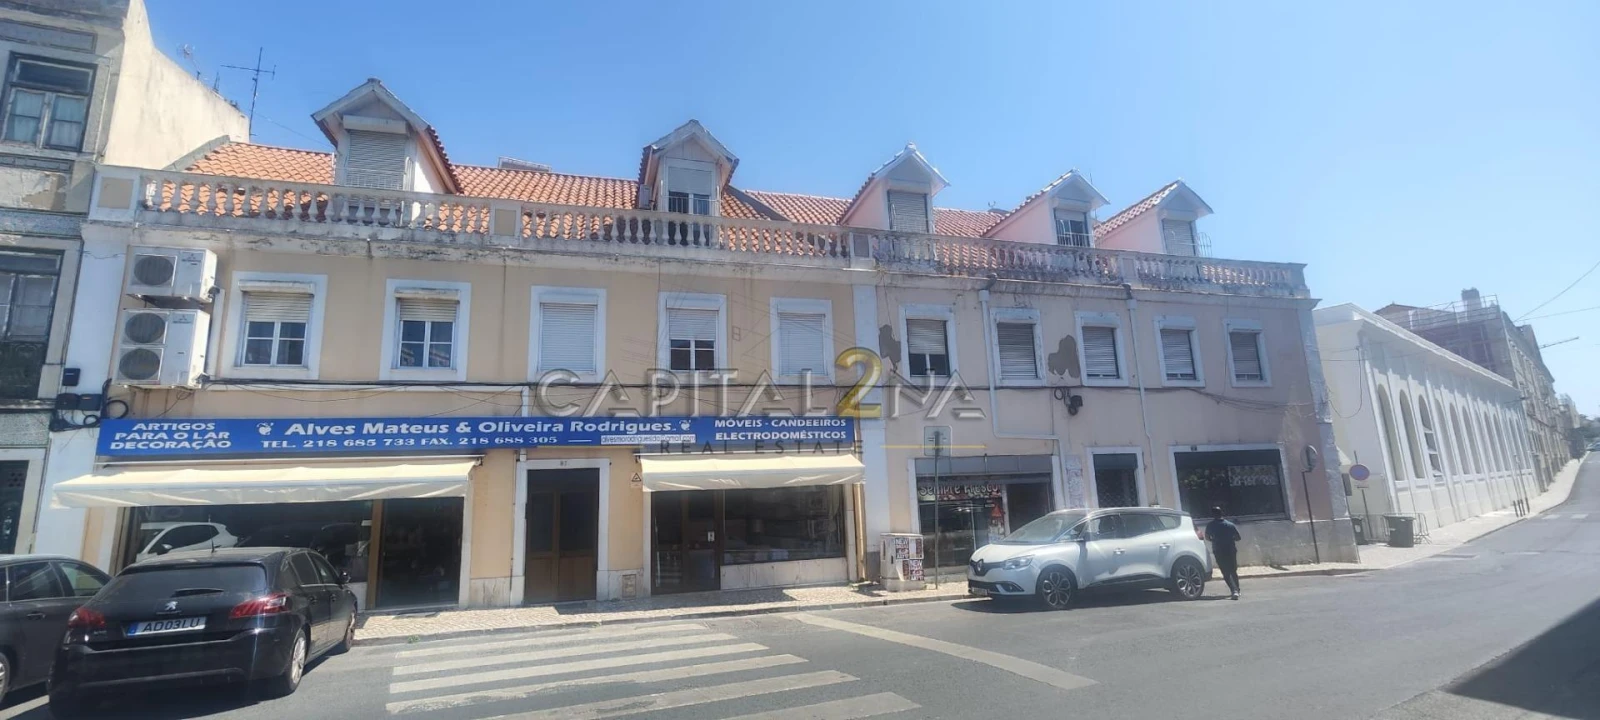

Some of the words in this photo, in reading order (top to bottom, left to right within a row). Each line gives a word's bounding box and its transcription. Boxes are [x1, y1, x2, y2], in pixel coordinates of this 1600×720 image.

[131, 422, 216, 431] ARTIGOS
[284, 423, 356, 435] Alves
[362, 422, 449, 434] Mateus
[455, 421, 472, 433] &
[478, 421, 564, 433] Oliveira
[714, 417, 763, 428] MÓVEIS
[771, 418, 847, 428] CANDEEIROS
[114, 432, 169, 441] PARA
[173, 432, 189, 440] O
[192, 431, 230, 440] LAR
[715, 430, 847, 441] ELECTRODOMÉSTICOS
[109, 439, 232, 450] DECORAÇÃO
[261, 440, 296, 448] TEL.
[303, 439, 338, 447] 218
[343, 439, 377, 447] 685
[383, 438, 415, 446] 733
[421, 437, 453, 446] FAX.
[459, 437, 490, 445] 218
[494, 436, 524, 444] 688
[529, 436, 558, 444] 305
[142, 617, 200, 632] AD03LU
